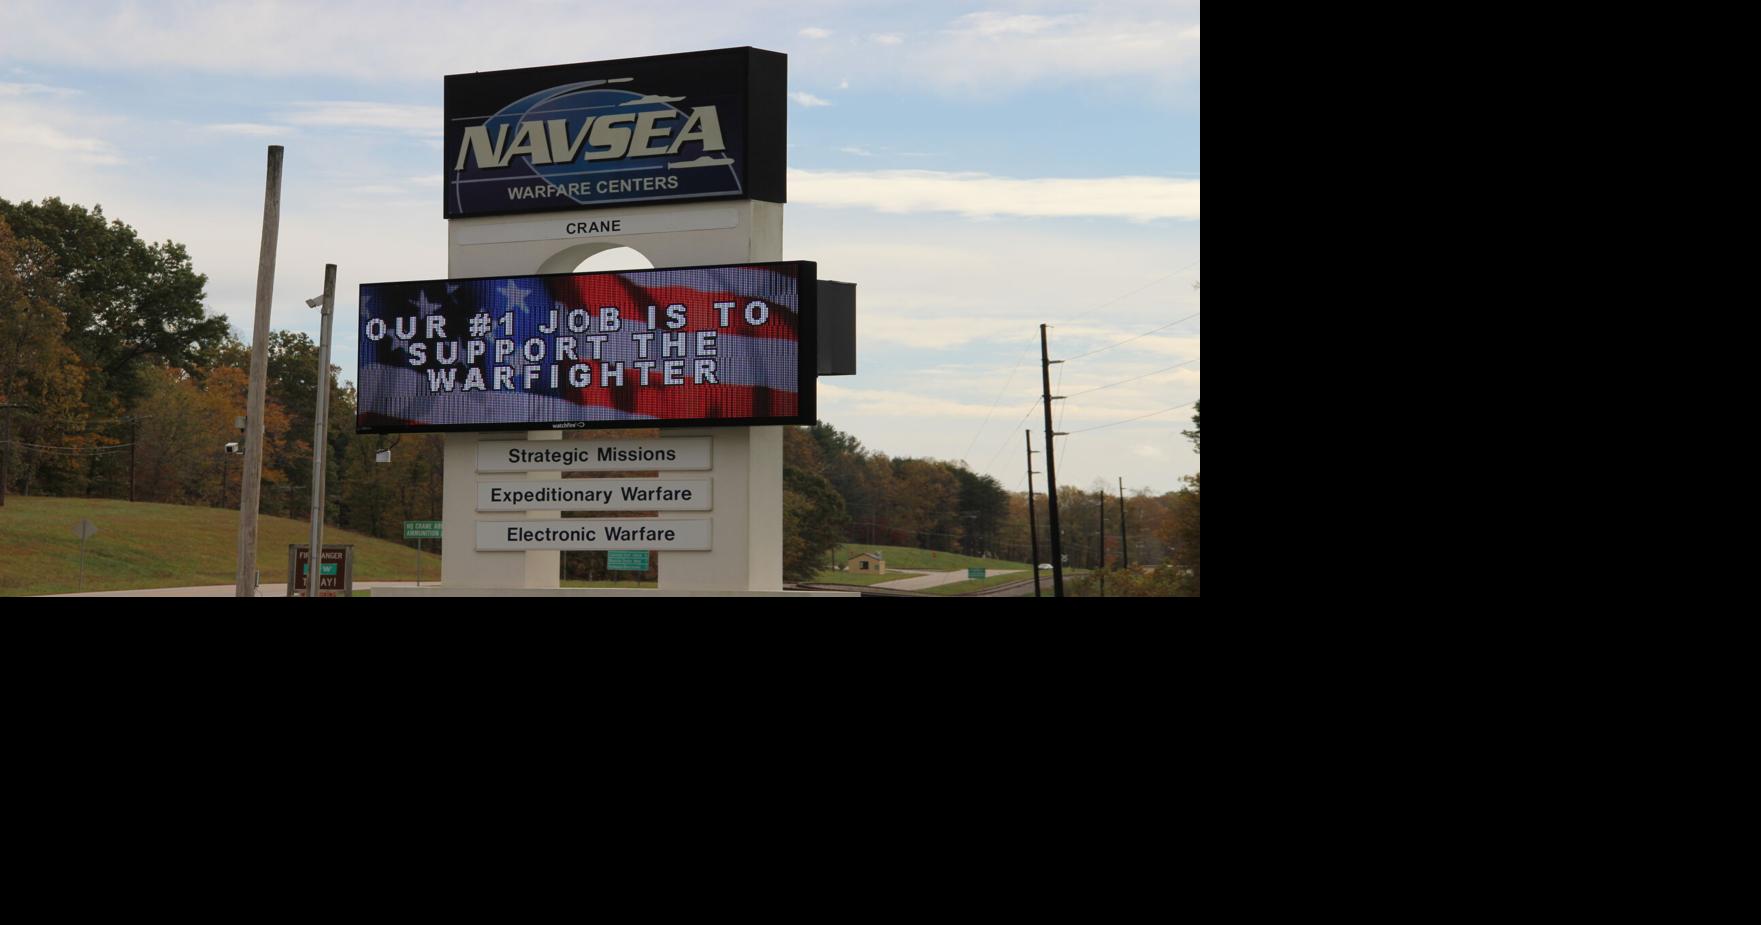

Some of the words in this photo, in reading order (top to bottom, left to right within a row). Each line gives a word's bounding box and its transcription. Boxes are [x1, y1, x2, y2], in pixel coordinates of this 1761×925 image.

[453, 105, 726, 171] NAVSEA
[507, 177, 591, 200] WARFARE
[596, 175, 679, 194] CENTERS
[566, 219, 621, 235] CRANE
[365, 313, 446, 341] OUR
[469, 311, 514, 337] #1
[538, 307, 622, 334] JOB
[647, 303, 687, 329] IS
[713, 300, 769, 327] TO
[408, 334, 608, 366] SUPPORT
[633, 330, 717, 360] THE
[427, 358, 719, 393] WARFIGHTER
[508, 448, 588, 465] Strategic
[597, 447, 676, 462] Missions
[491, 487, 612, 505] Expeditionary
[621, 486, 692, 501] Warfare
[507, 527, 596, 542] Electronic
[605, 526, 675, 541] Warfare
[320, 551, 343, 560] ANGER
